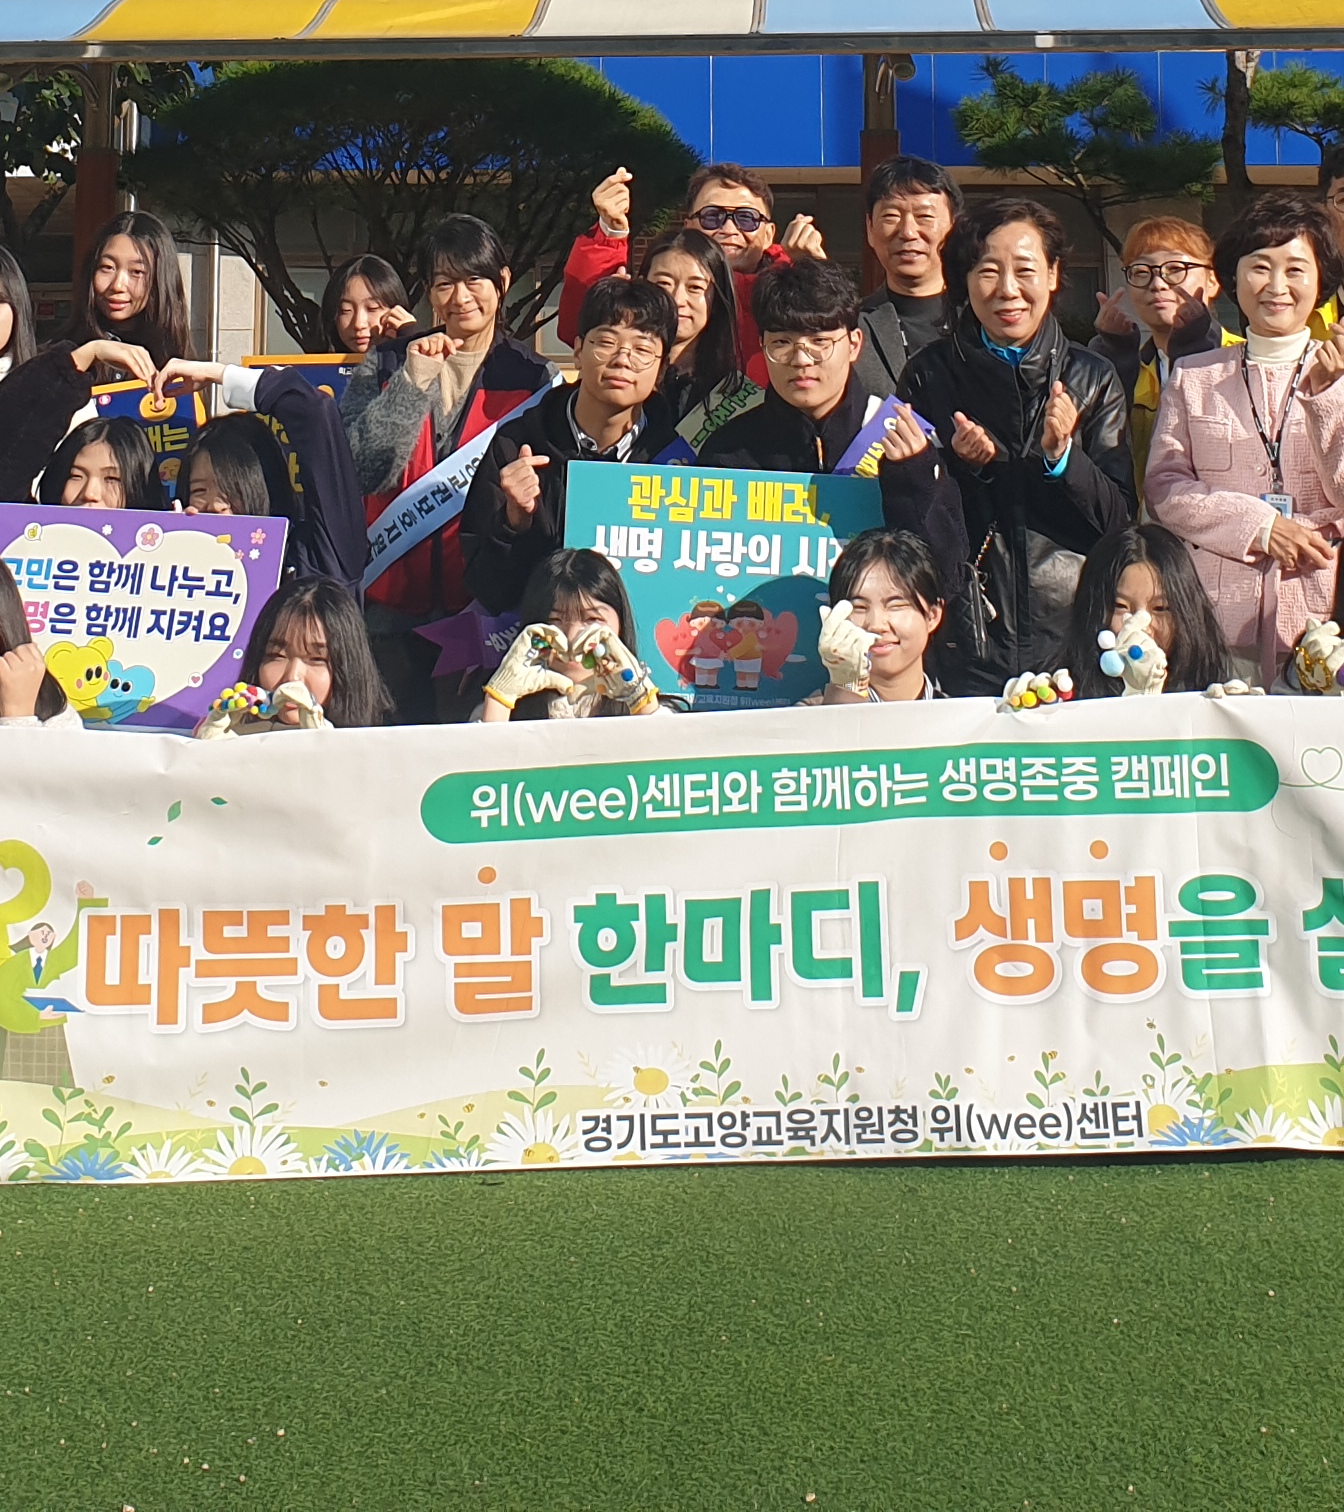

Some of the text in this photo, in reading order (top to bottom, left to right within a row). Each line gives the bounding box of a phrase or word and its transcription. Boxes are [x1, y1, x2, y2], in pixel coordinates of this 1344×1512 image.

[627, 475, 831, 527] 관심과 배려,
[673, 529, 781, 578] 사랑의
[88, 560, 144, 595] 함께
[150, 565, 242, 606] 나누고,
[85, 602, 142, 639] 함께
[146, 608, 232, 642] 지켜요
[469, 751, 1231, 829] 위(wee)센터와 함께하는 생명존중 캠페인
[84, 903, 411, 1027] 따뜻한
[441, 896, 545, 1016] 말
[576, 880, 923, 1015] 한마디,
[952, 872, 1269, 997] 생명을
[580, 1099, 1145, 1153] 경기도고양교육지원청 위(wee)센터
